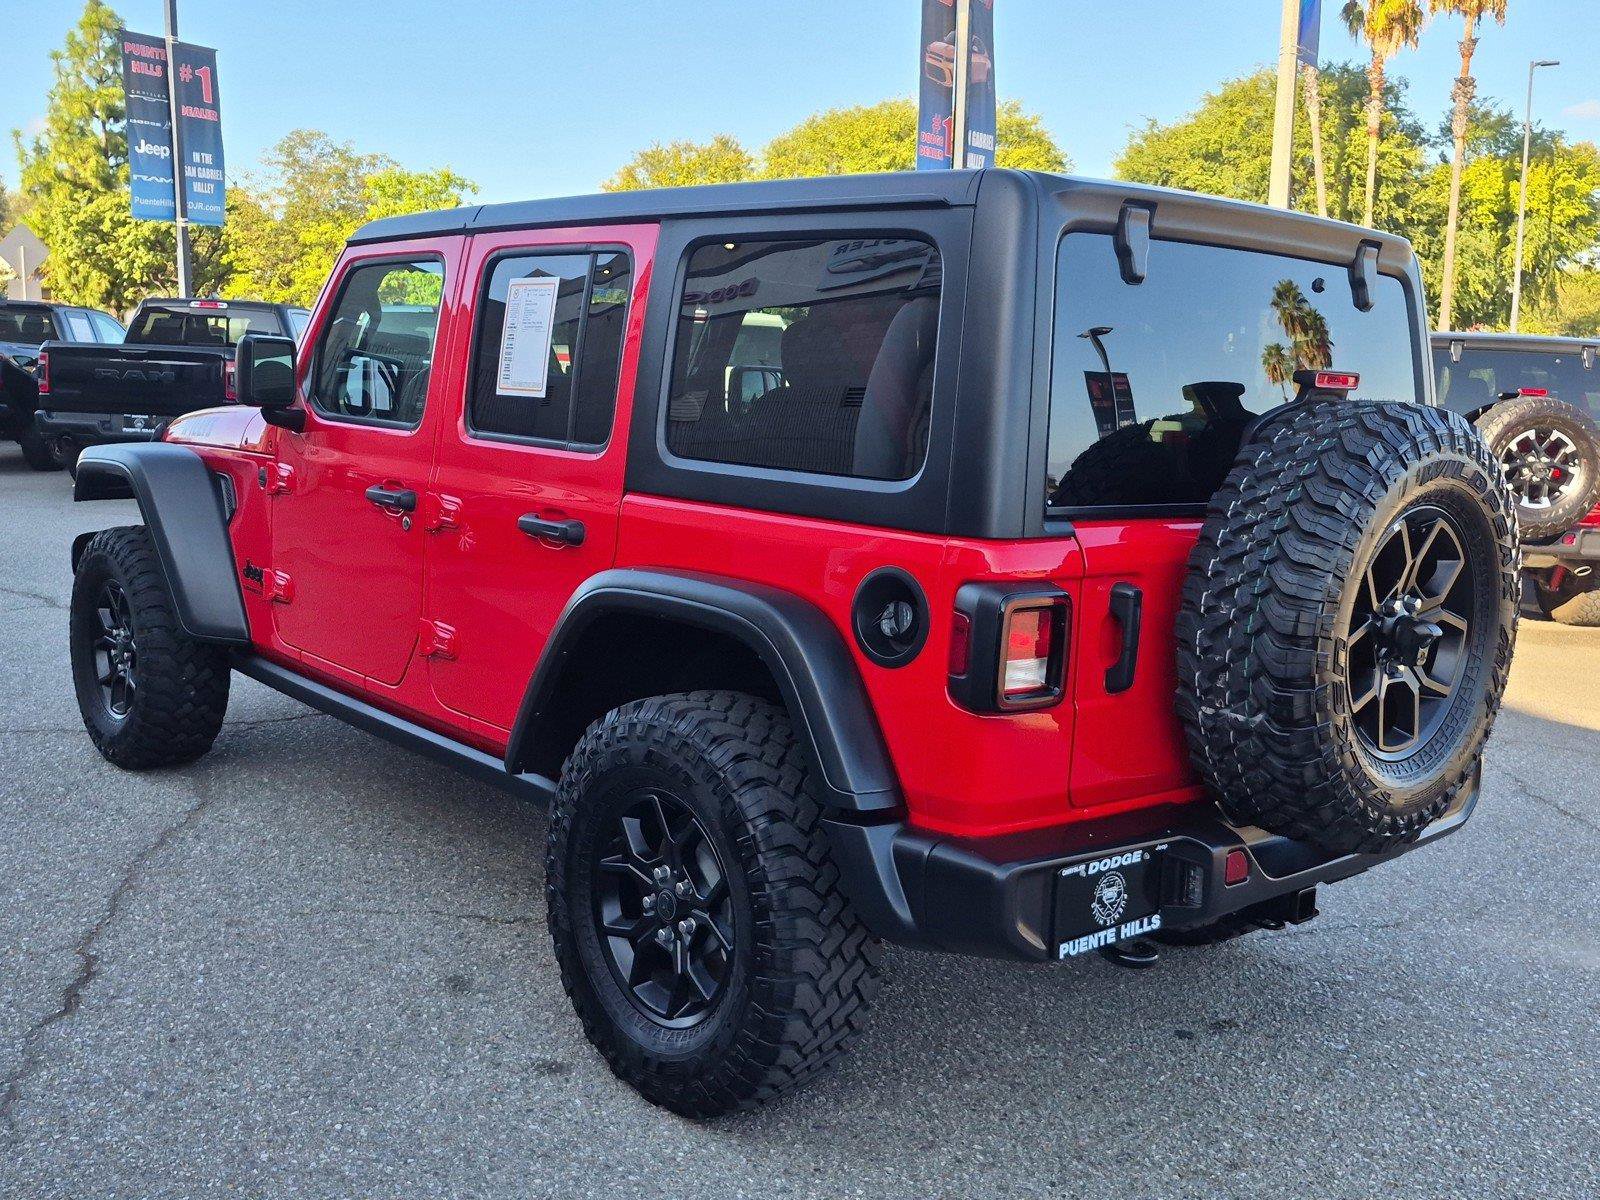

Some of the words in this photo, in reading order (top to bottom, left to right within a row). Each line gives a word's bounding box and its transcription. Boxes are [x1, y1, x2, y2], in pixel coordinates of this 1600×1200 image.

[124, 42, 166, 60] PUENTE
[131, 60, 163, 77] HILLS
[179, 63, 213, 104] #1
[181, 105, 218, 122] DEALER
[134, 139, 170, 159] Jeep
[193, 151, 200, 163] IN
[201, 152, 213, 165] THE
[197, 166, 223, 181] GABRIEL
[192, 181, 214, 194] VALLEY
[94, 368, 175, 382] RAM
[1087, 850, 1143, 875] DODGE
[1059, 927, 1117, 960] PUENTE
[1120, 914, 1161, 939] HILLS
